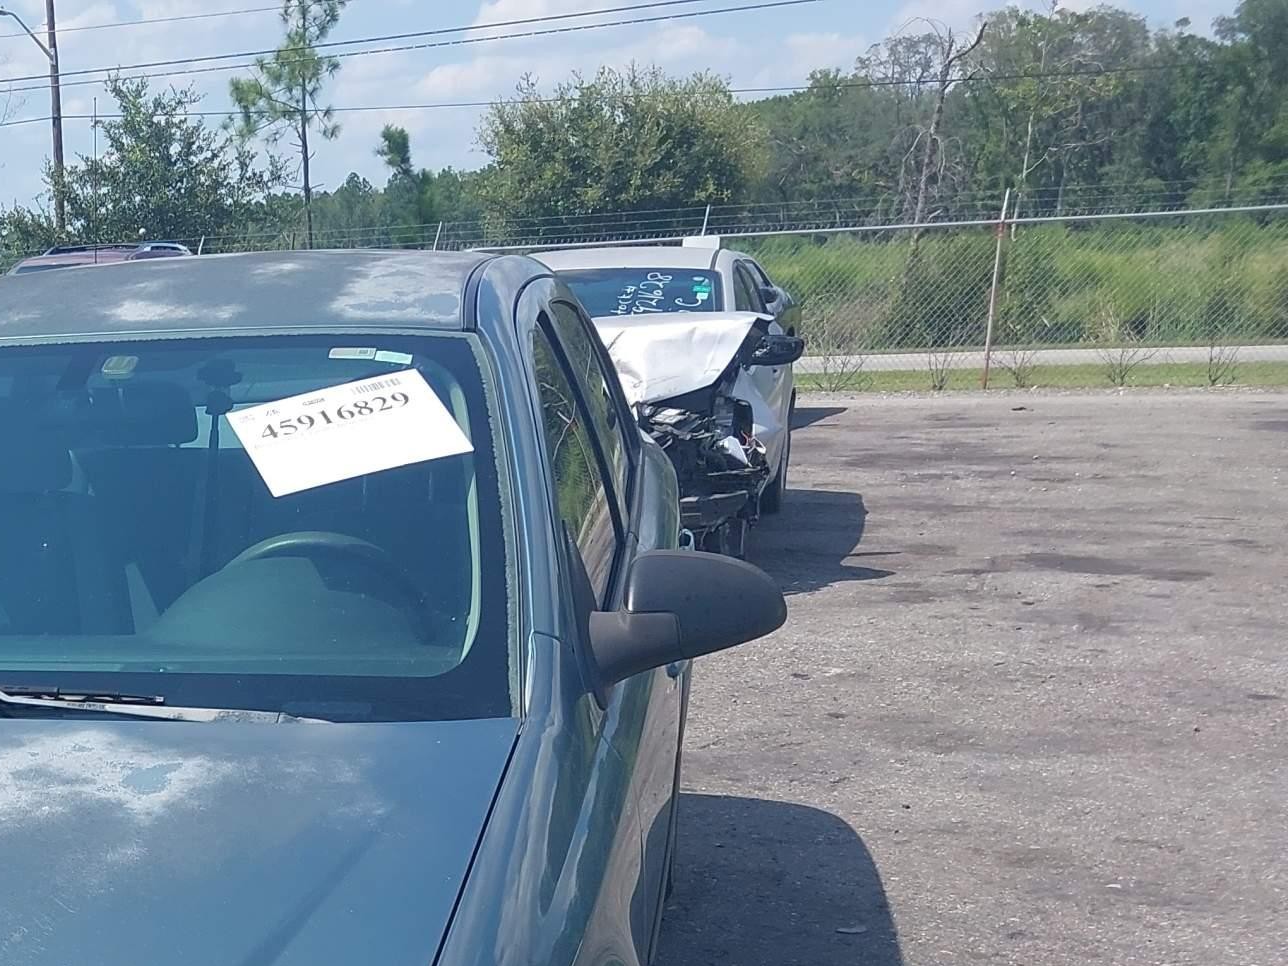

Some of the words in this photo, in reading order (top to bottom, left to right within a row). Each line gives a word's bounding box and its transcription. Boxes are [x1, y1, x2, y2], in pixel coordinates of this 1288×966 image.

[610, 285, 637, 315] tock#
[630, 272, 673, 315] 921628
[261, 391, 410, 439] 45916829
